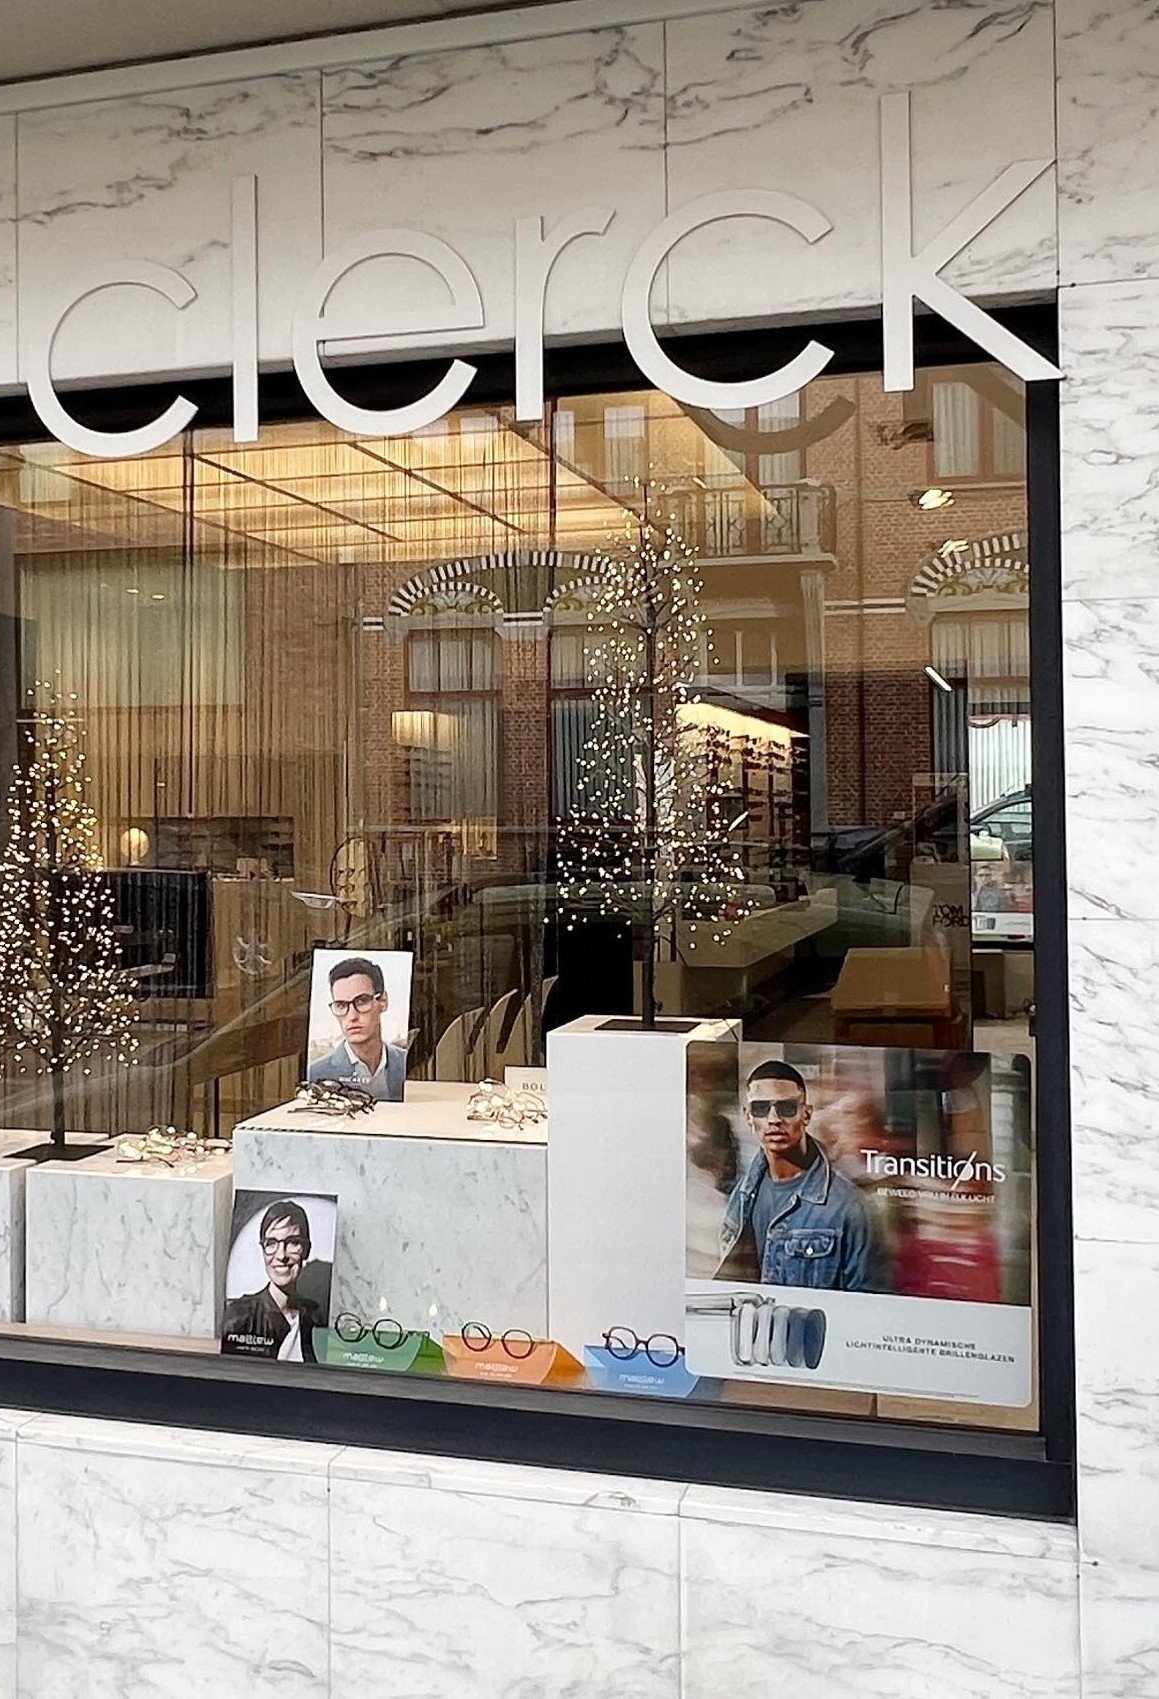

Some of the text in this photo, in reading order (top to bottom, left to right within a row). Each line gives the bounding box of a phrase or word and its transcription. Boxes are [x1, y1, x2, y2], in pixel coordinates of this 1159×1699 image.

[28, 91, 1064, 457] clerck
[882, 1335, 976, 1350] ULTRA DYNAMISCHE
